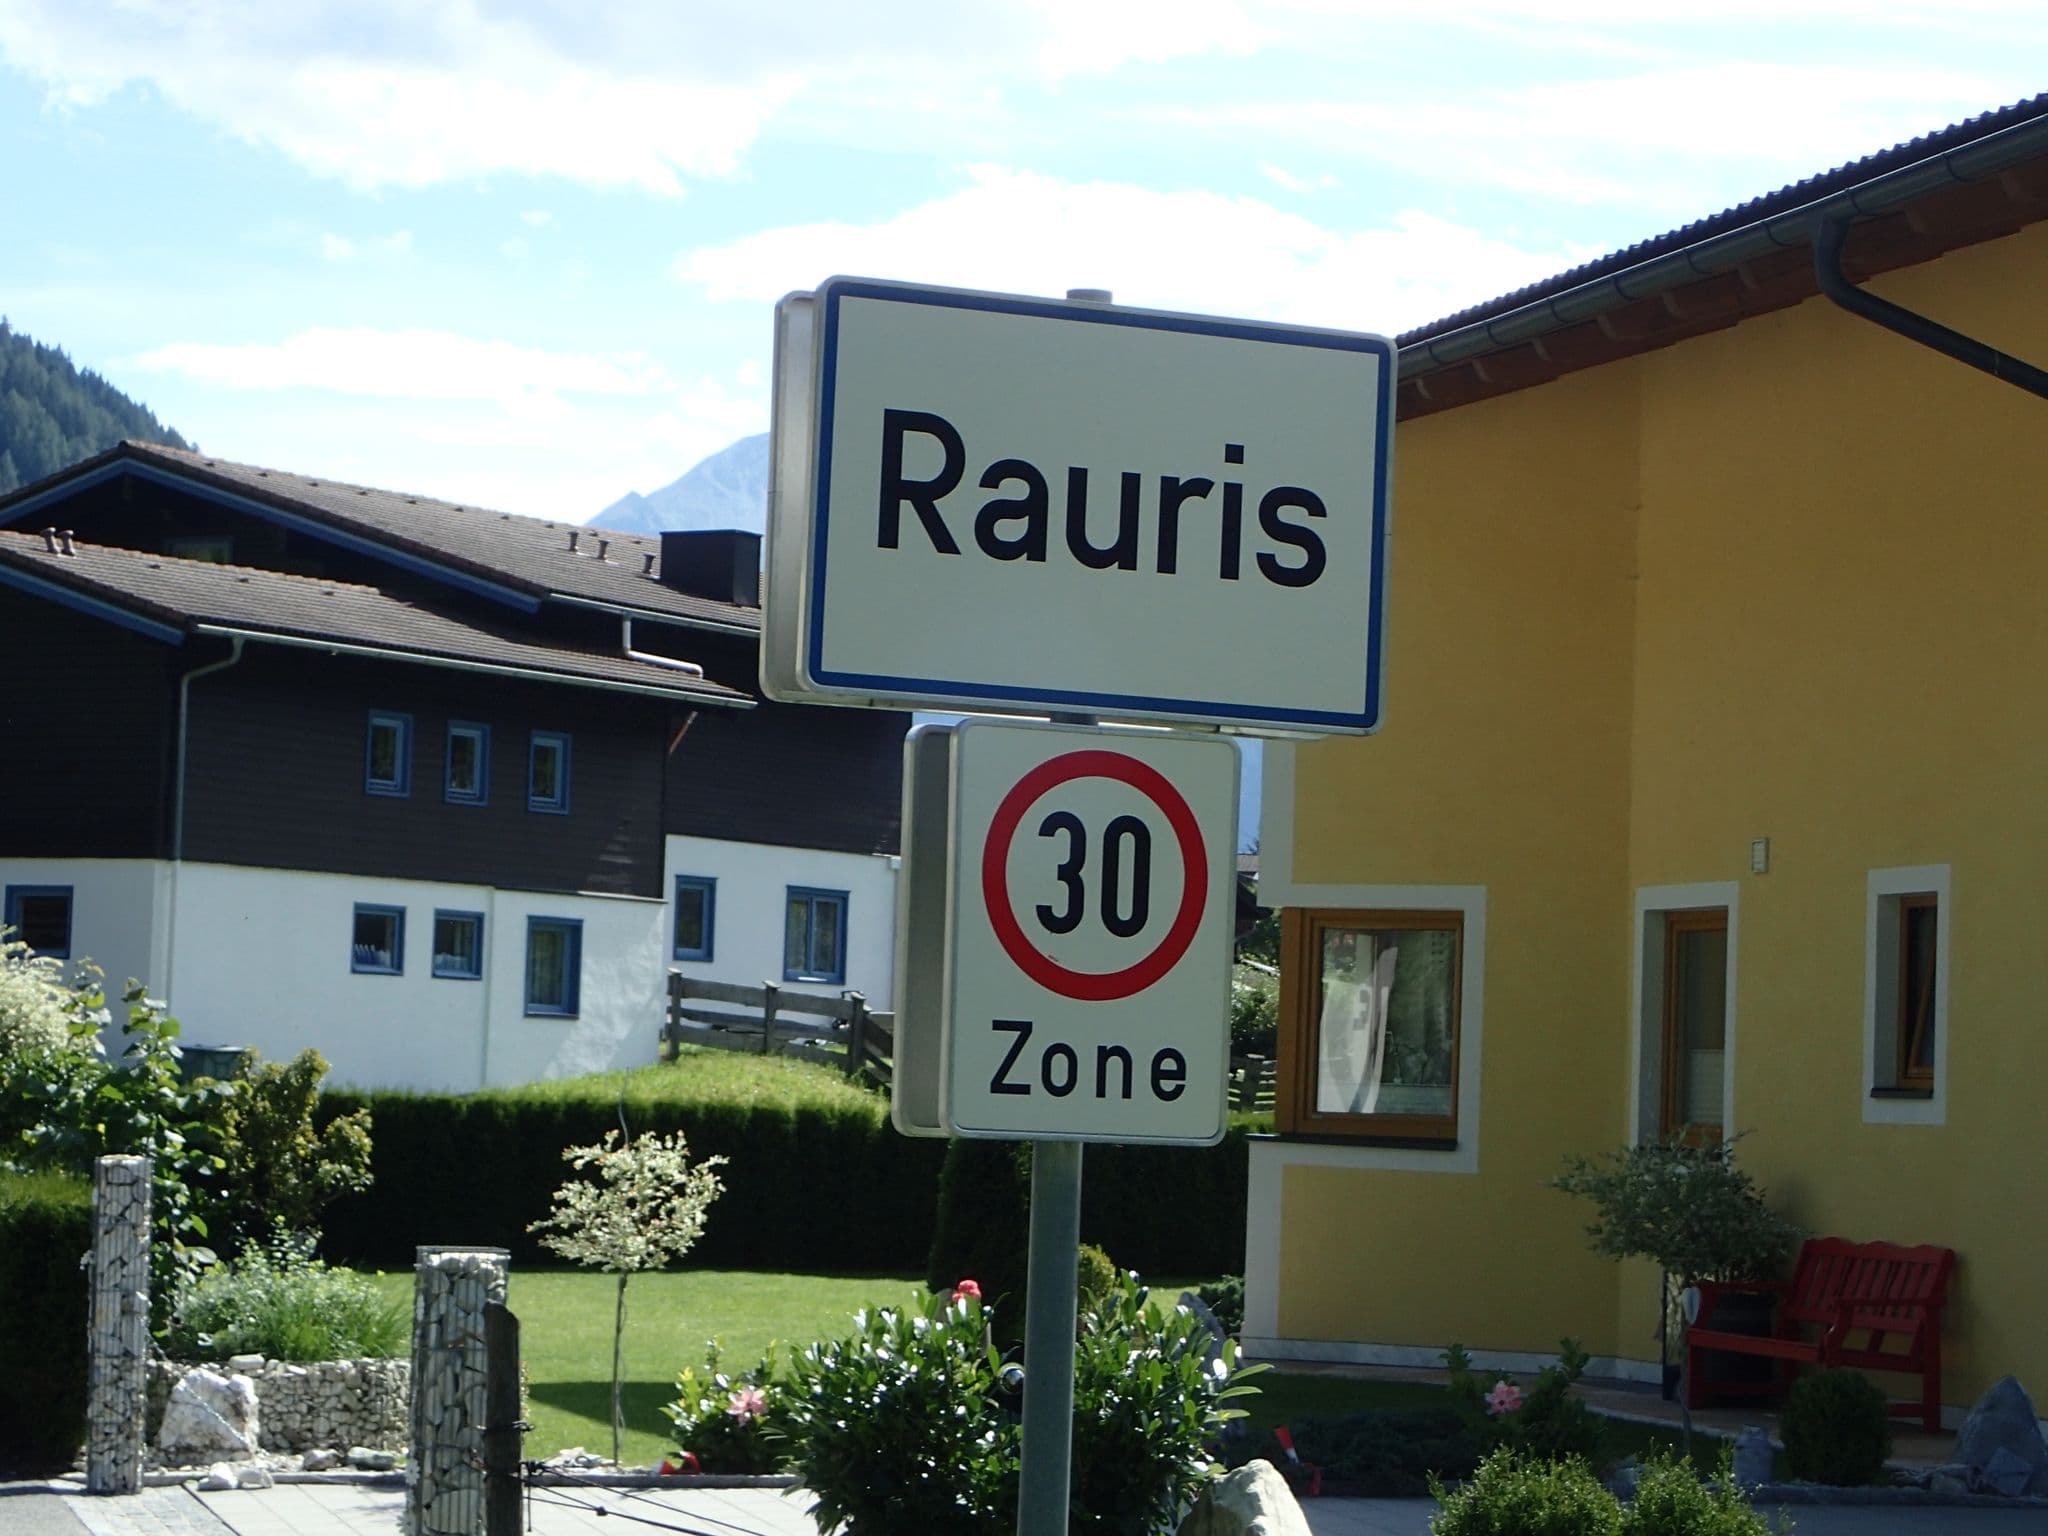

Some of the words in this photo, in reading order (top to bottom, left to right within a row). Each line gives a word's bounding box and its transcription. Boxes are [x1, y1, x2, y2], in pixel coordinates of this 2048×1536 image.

[877, 408, 1328, 588] Rauris
[1035, 811, 1152, 938] 30
[989, 1019, 1187, 1102] Zone
